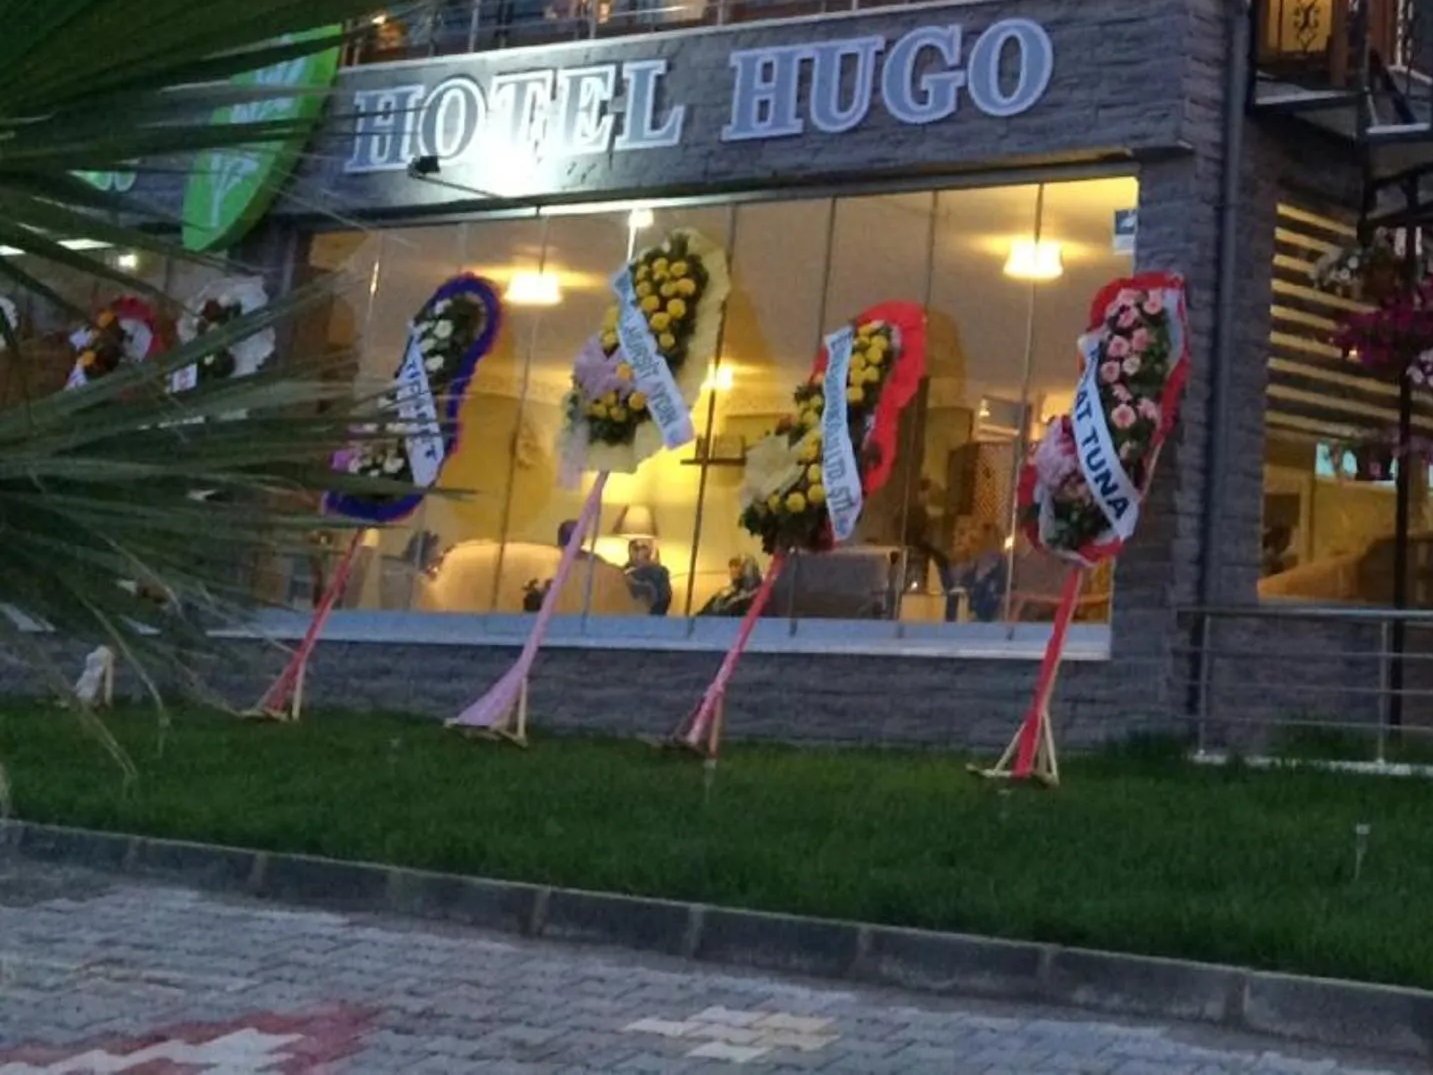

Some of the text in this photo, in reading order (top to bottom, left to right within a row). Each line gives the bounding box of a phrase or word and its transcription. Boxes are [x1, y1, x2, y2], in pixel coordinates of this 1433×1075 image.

[345, 18, 1054, 173] HOTEL HUGO
[1081, 427, 1130, 520] TUNA
